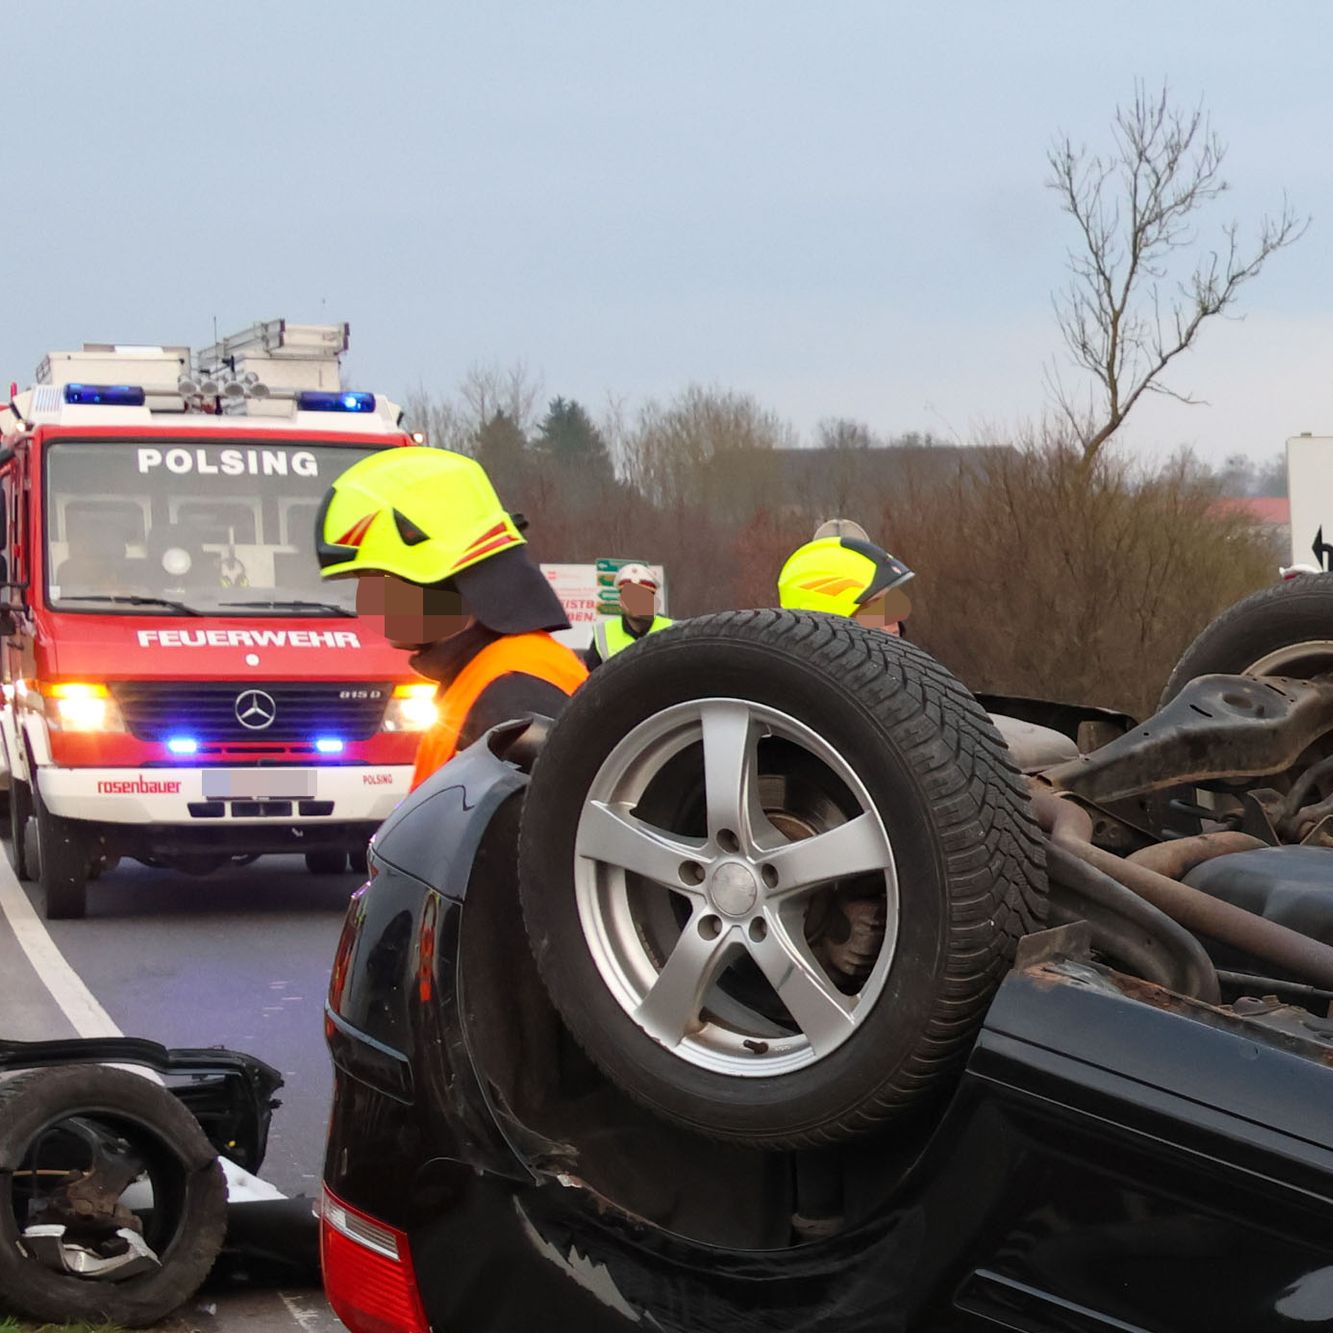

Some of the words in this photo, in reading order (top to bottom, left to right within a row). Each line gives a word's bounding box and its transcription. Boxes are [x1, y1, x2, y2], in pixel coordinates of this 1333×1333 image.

[137, 448, 319, 477] POLSING
[136, 629, 361, 648] FEUERWEHR
[97, 775, 182, 794] rosenbauer
[363, 774, 393, 785] POLSING
